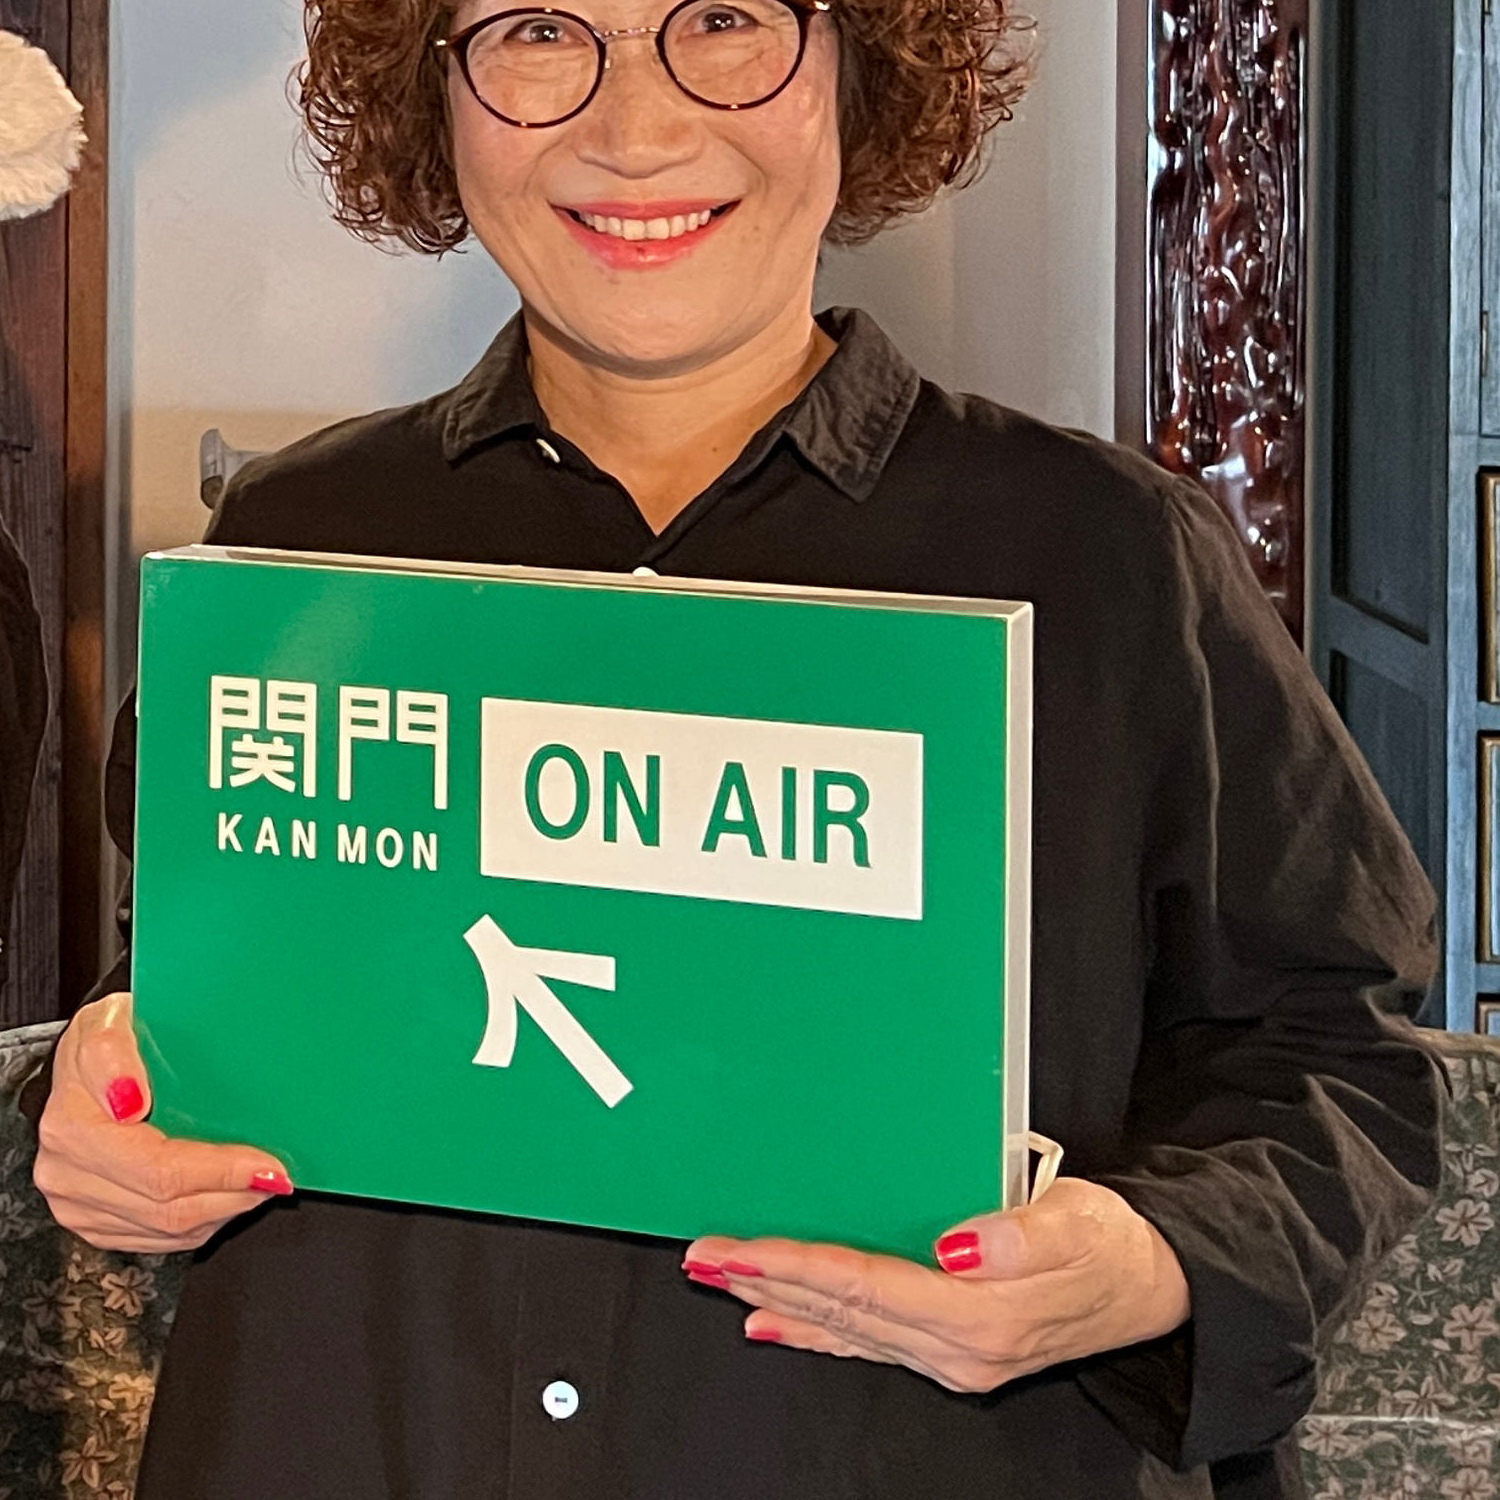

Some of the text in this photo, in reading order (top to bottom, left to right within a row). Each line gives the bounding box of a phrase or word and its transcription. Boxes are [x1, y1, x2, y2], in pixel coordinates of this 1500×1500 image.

[207, 674, 449, 810] 関門
[524, 742, 871, 868] ON AIR
[216, 811, 439, 872] KAN MON
